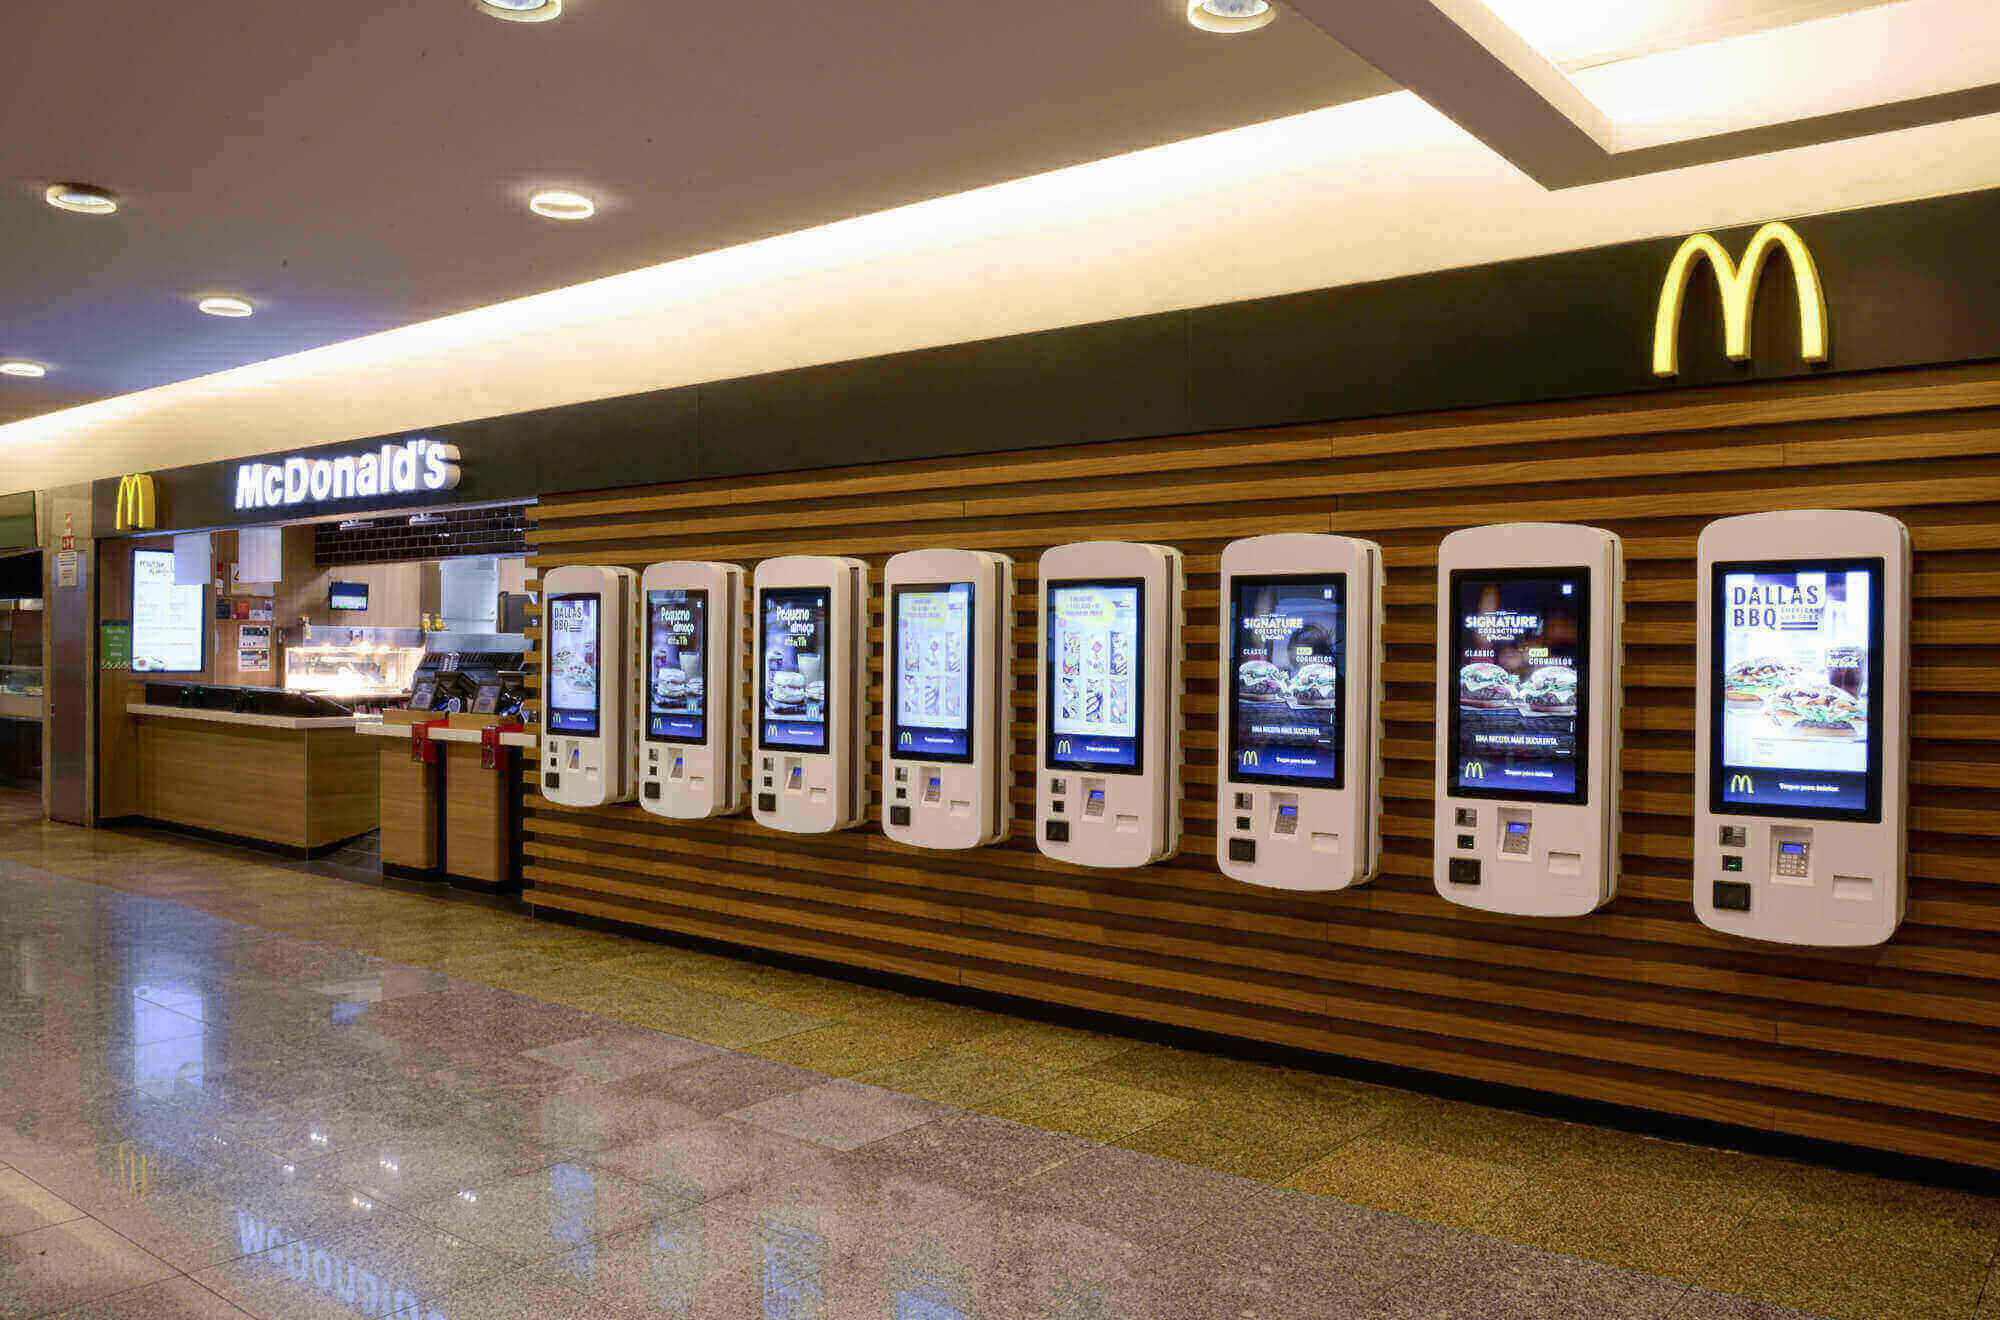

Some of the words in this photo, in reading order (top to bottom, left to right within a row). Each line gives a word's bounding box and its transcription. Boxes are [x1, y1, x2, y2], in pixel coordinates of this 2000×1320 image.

[235, 439, 450, 509] McDonald's
[1734, 585, 1818, 605] DALLAS
[554, 607, 582, 618] DALLAS
[1734, 608, 1776, 630] BBQ
[1242, 617, 1303, 629] SIGNATURE
[1464, 615, 1537, 628] SIGNATURE
